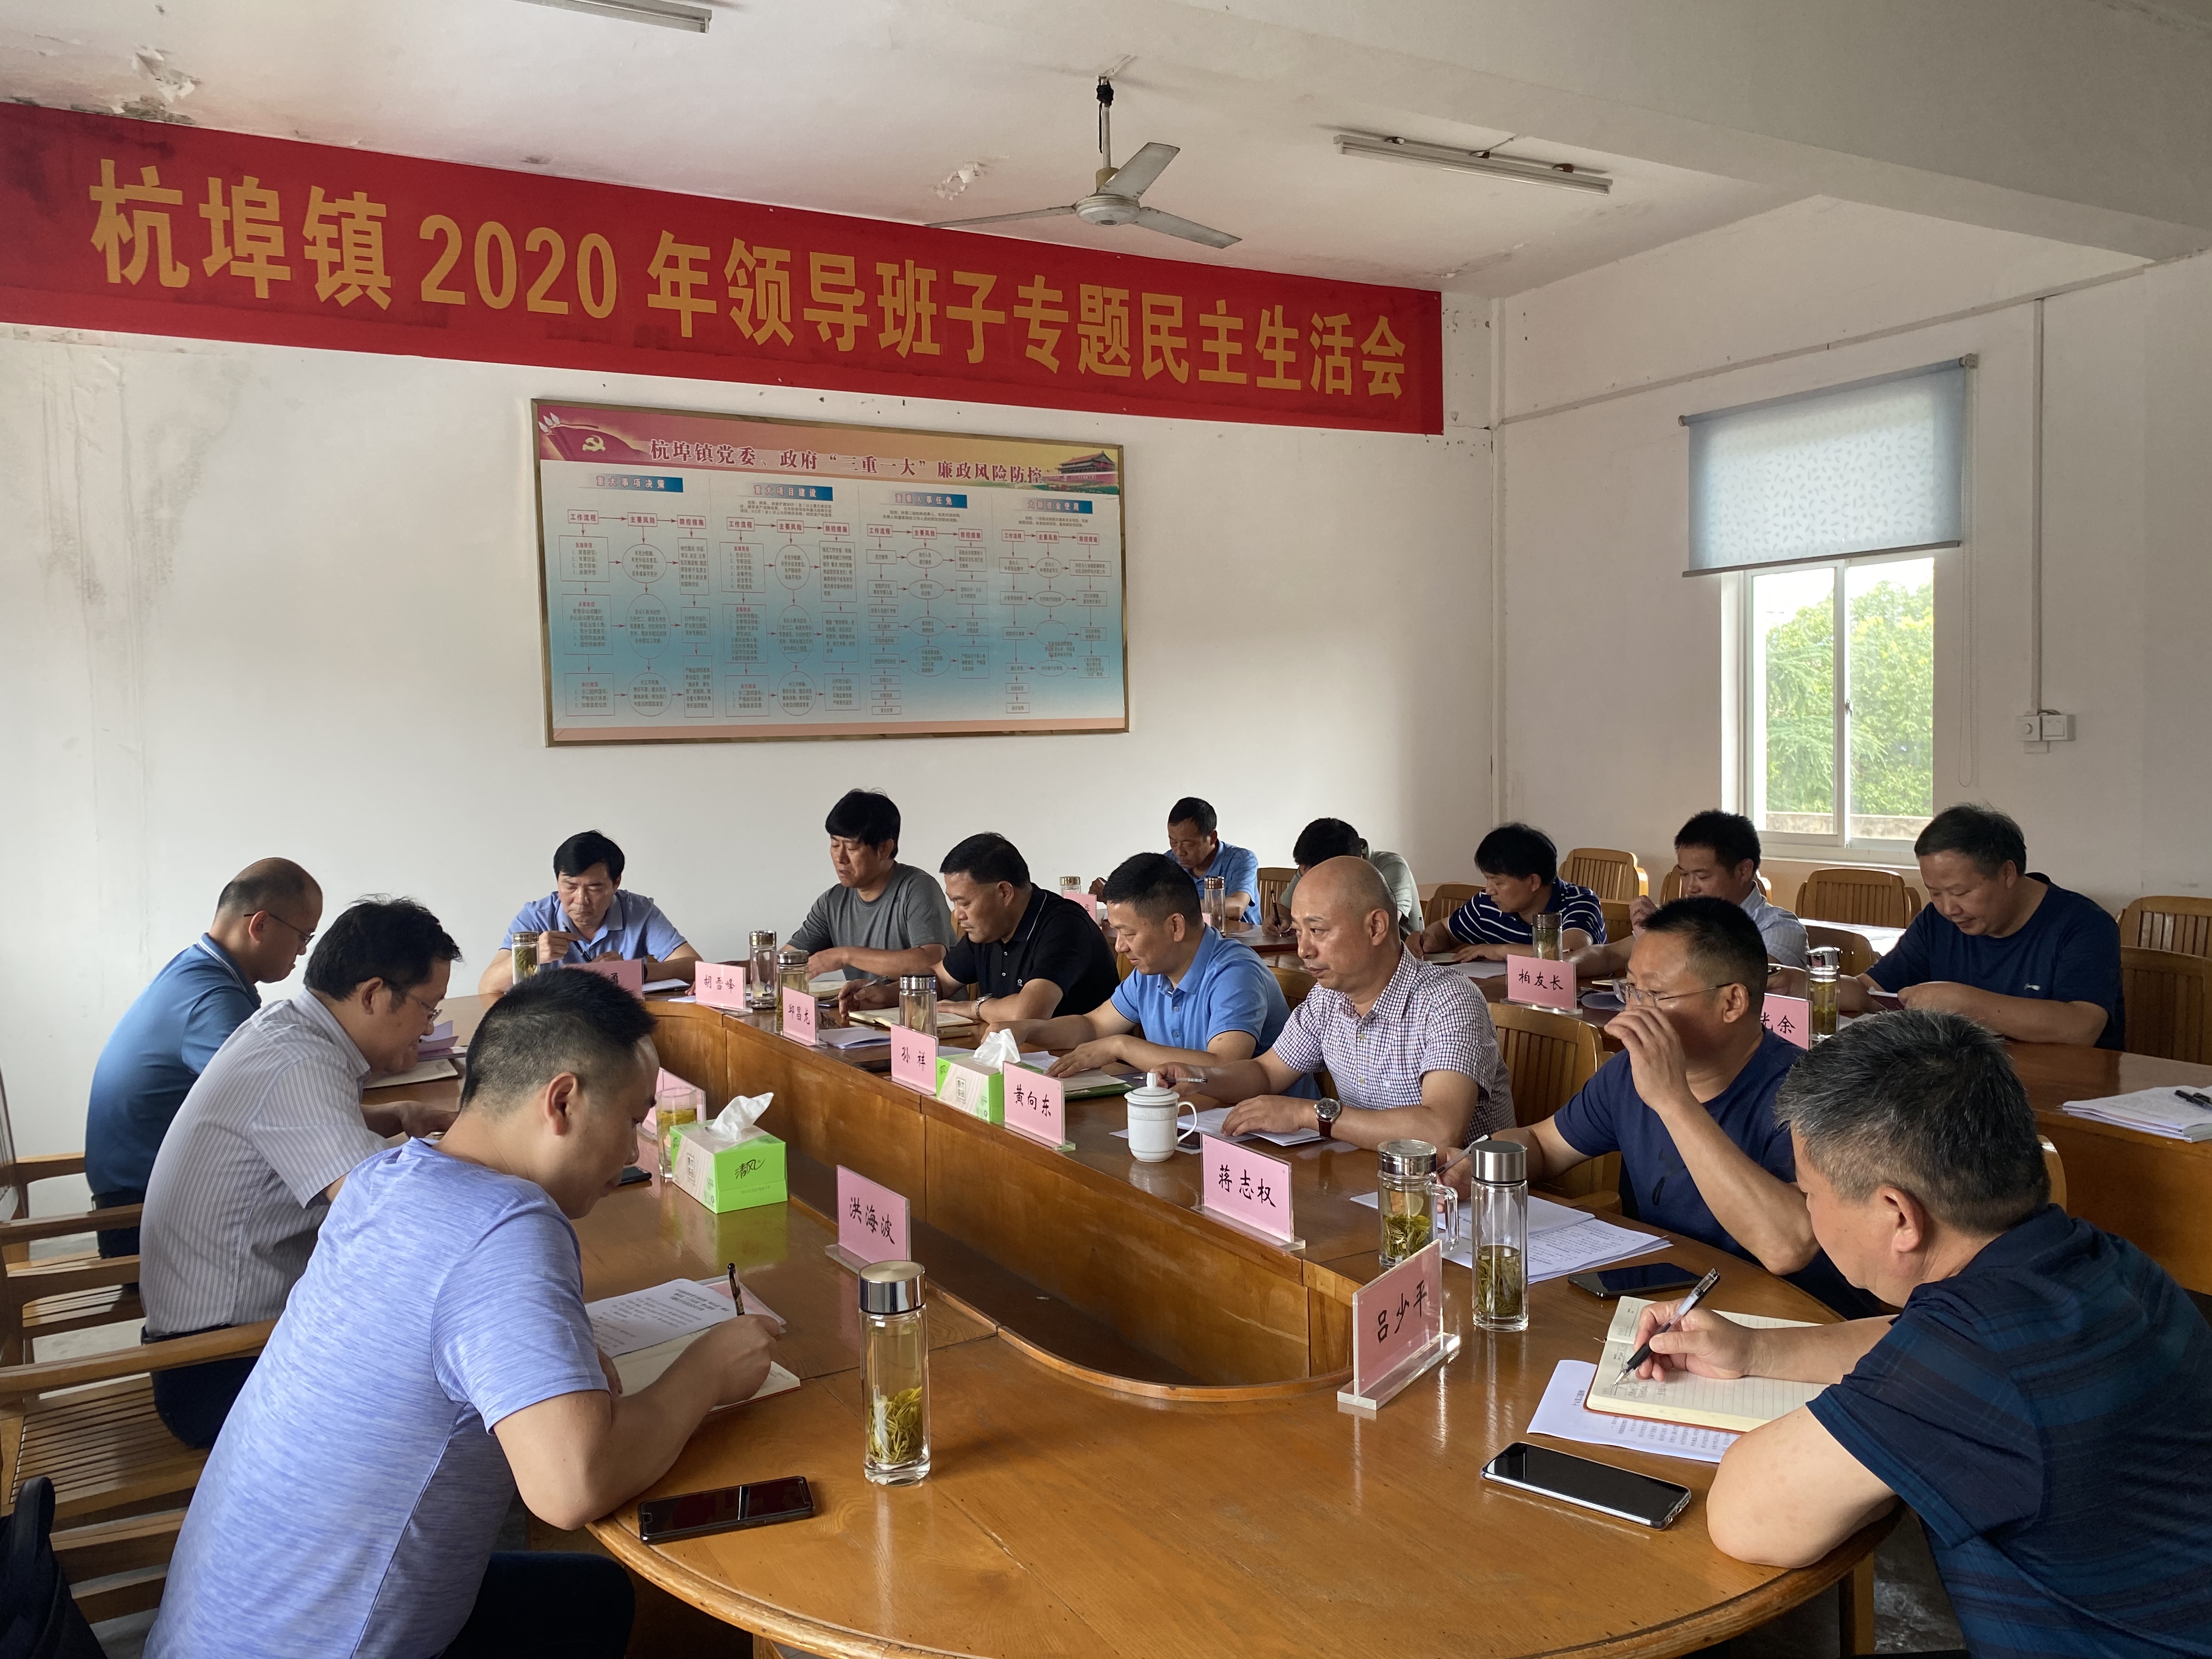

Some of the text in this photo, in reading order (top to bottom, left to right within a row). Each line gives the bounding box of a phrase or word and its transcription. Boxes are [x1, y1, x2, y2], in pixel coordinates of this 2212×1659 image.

[89, 159, 1406, 400] 杭埠镇 2020 年领导班子专题民主生活会
[596, 476, 665, 489] 重大事项决策
[754, 485, 816, 498] 重大项目建设
[895, 493, 952, 505] 重要人事任免
[703, 974, 736, 994] 胡雪峰
[1518, 969, 1564, 991] 柏友长
[901, 1047, 926, 1071] 孙祥
[1013, 1084, 1051, 1117] 黄向东
[735, 1159, 765, 1179] 清风
[1218, 1165, 1276, 1208] 蒋志权
[849, 1197, 895, 1245] 洪海波
[1376, 1279, 1427, 1344] 吕少平
